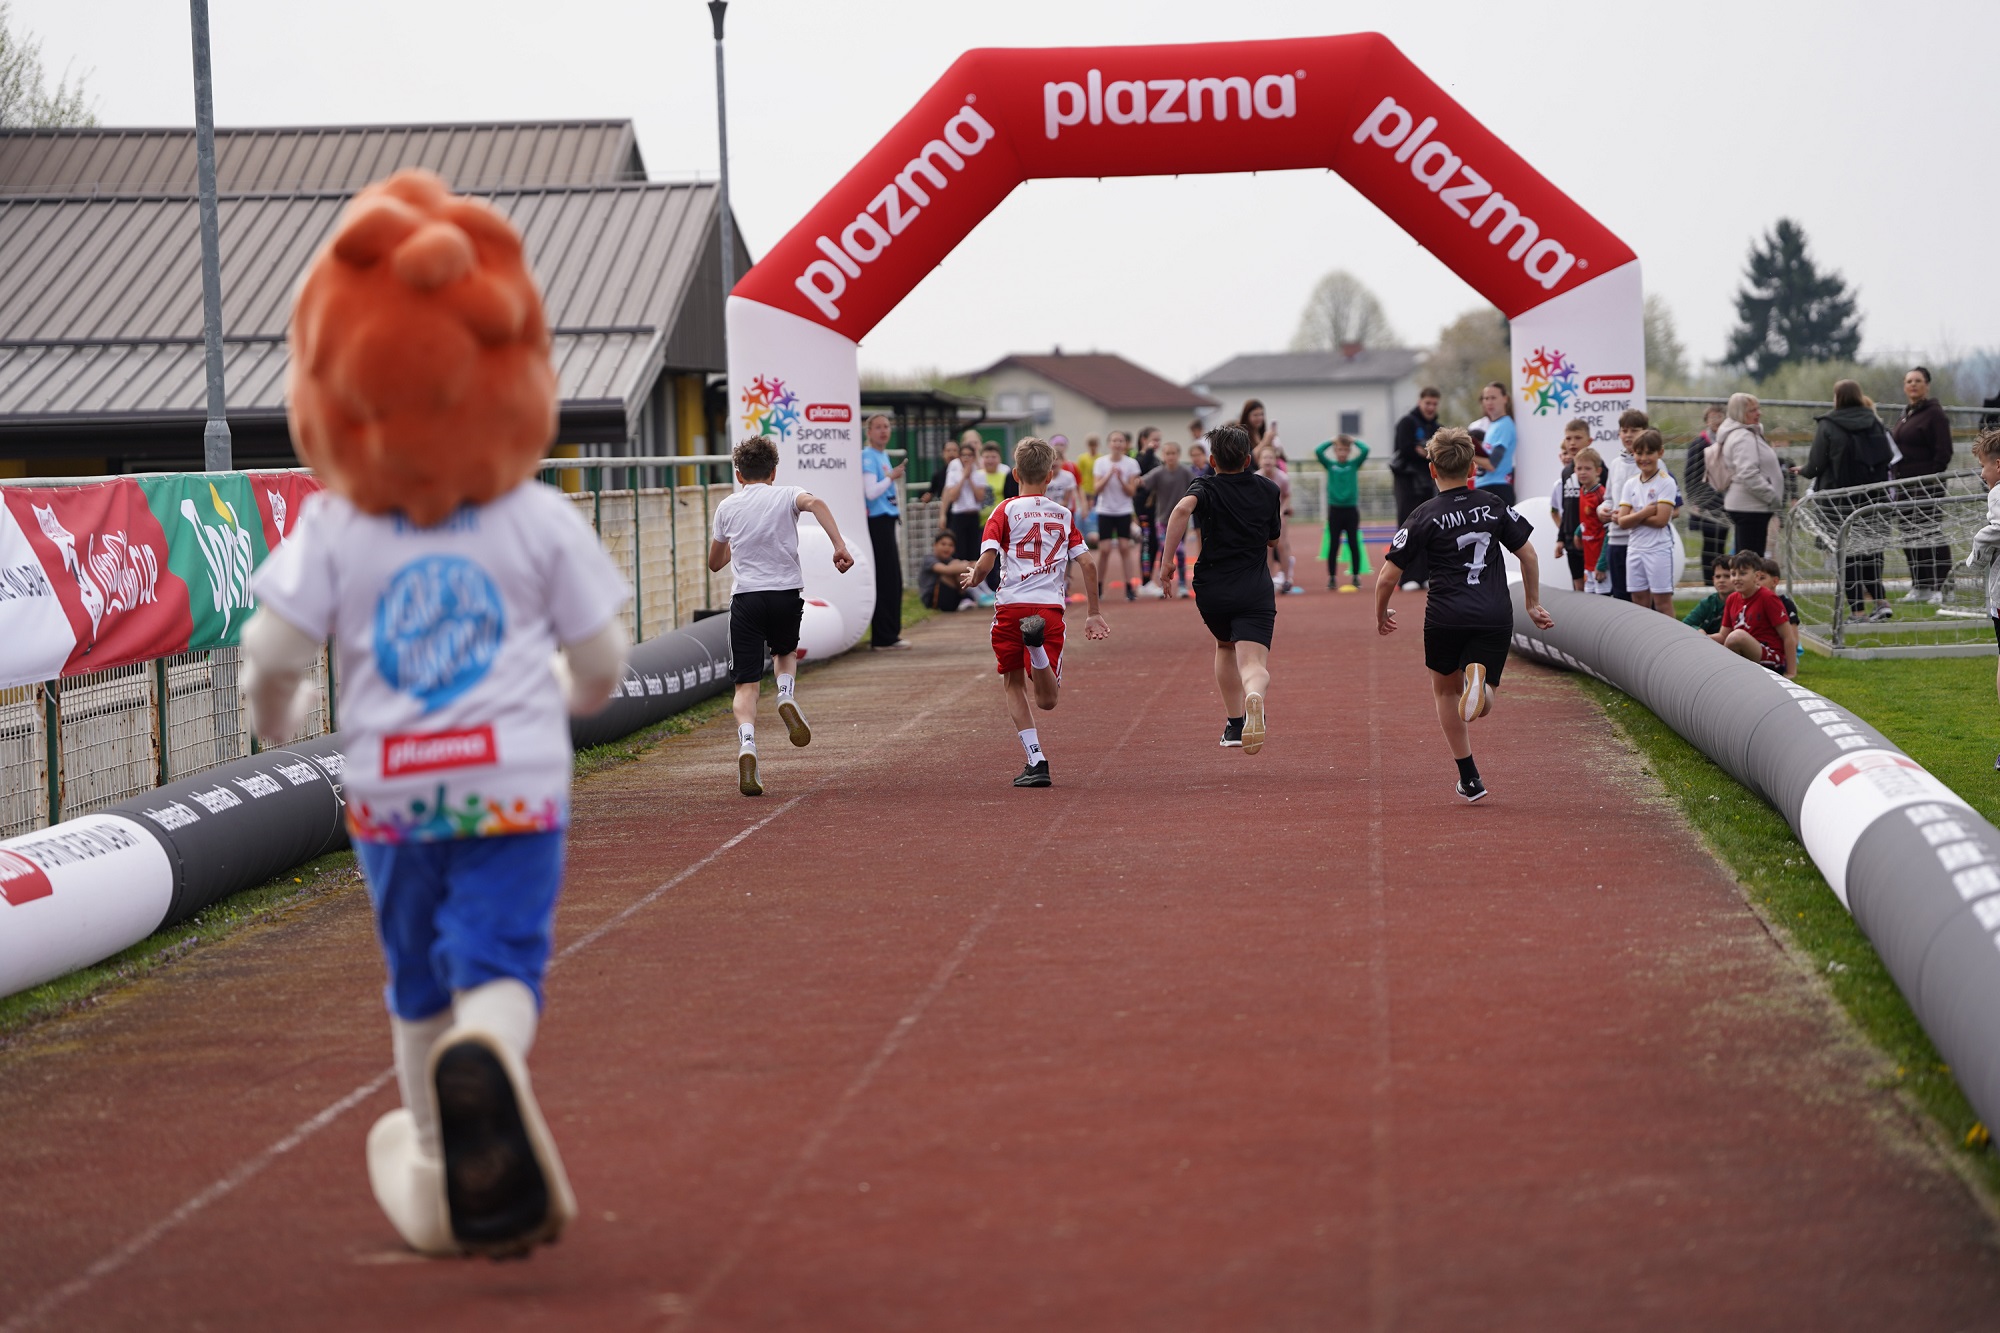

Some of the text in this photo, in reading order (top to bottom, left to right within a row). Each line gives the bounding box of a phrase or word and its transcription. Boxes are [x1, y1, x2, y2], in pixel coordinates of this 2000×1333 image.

[1043, 68, 1296, 139] plazma
[1352, 96, 1577, 290] plazma
[795, 104, 995, 320] plazma
[1588, 377, 1631, 392] plazma
[809, 405, 849, 420] plazma
[796, 426, 851, 441] ŠPORTNE
[797, 442, 827, 455] IGRE
[797, 457, 847, 470] MLADIH
[1013, 513, 1022, 522] FC
[1023, 511, 1042, 519] BAYERN
[1433, 510, 1467, 531] VINI
[1016, 522, 1067, 568] 42
[1456, 531, 1493, 585] 7
[128, 544, 159, 606] CUP
[387, 735, 487, 771] plazma
